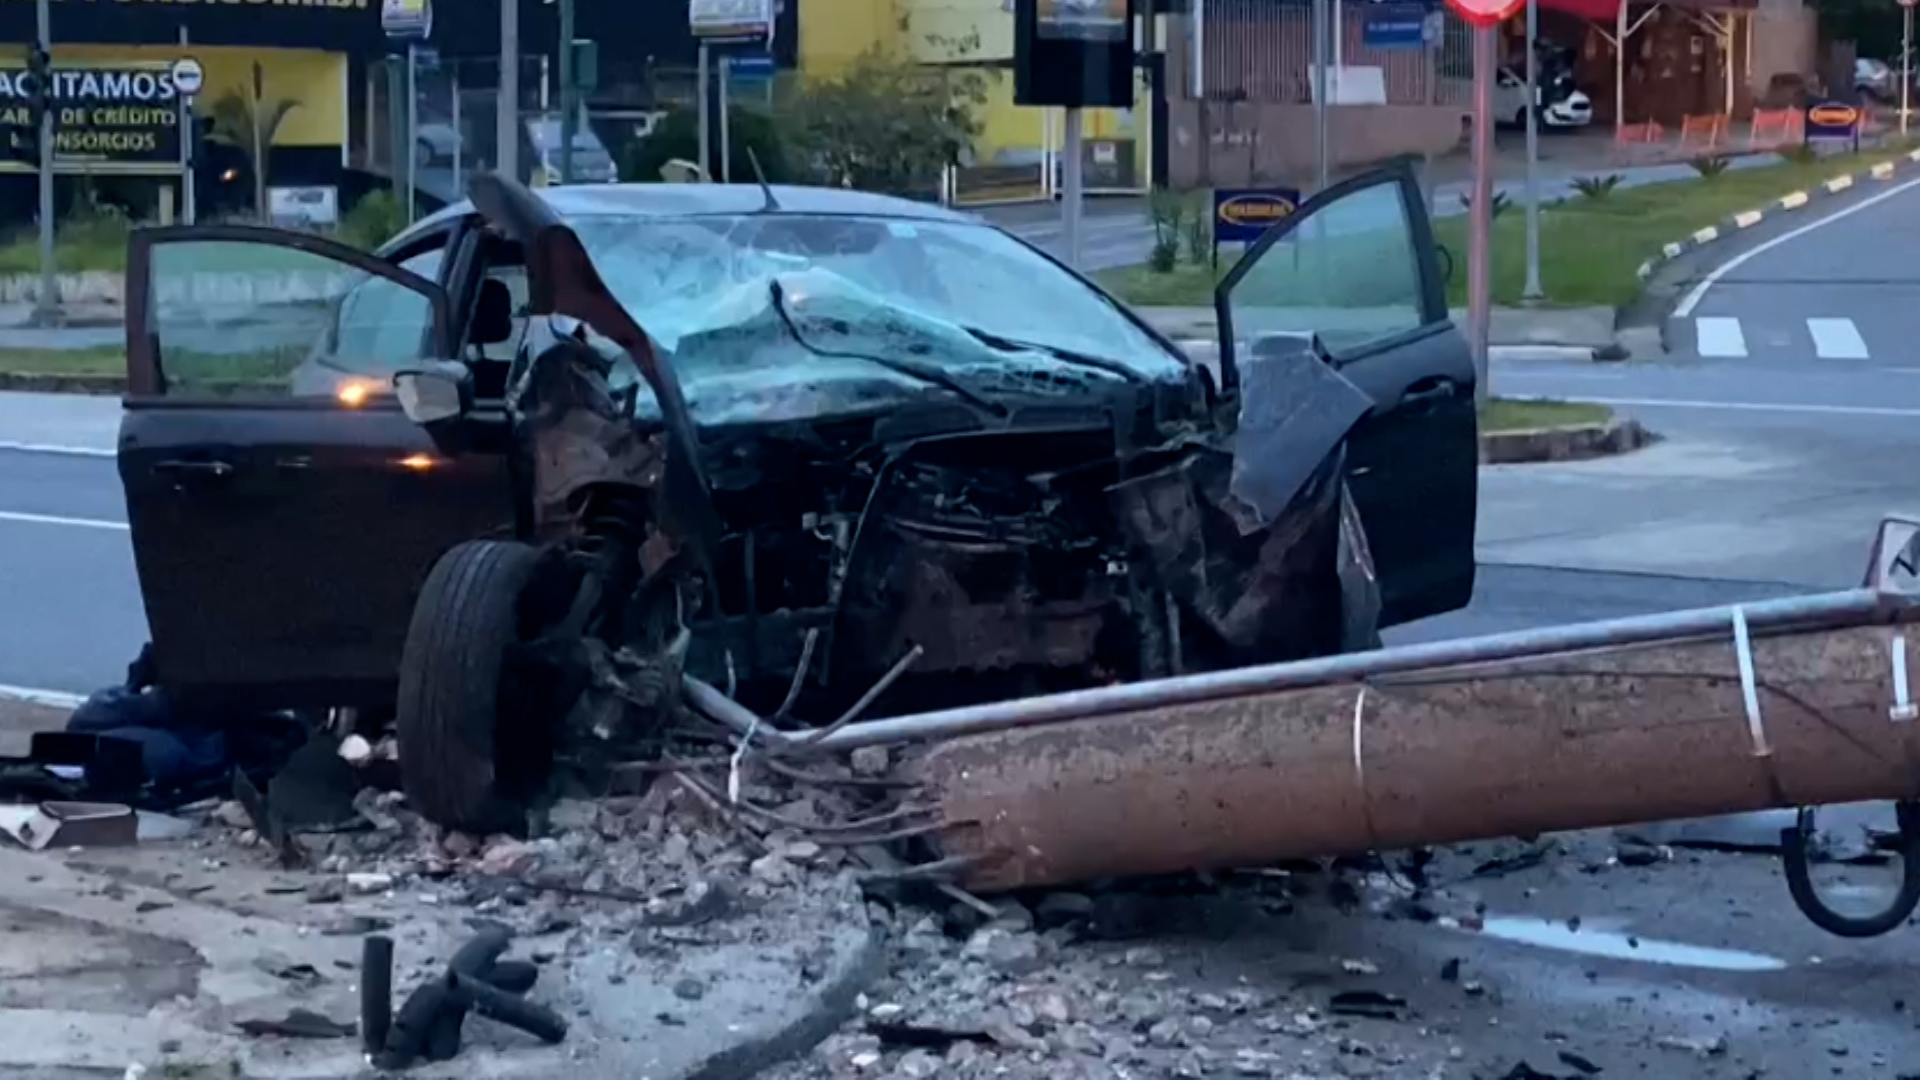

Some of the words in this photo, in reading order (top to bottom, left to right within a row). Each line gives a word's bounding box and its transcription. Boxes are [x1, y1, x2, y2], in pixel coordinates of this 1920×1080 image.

[0, 71, 175, 99] ACITAMOS
[61, 107, 85, 124] DE
[54, 128, 156, 150] NSÓRCIOS
